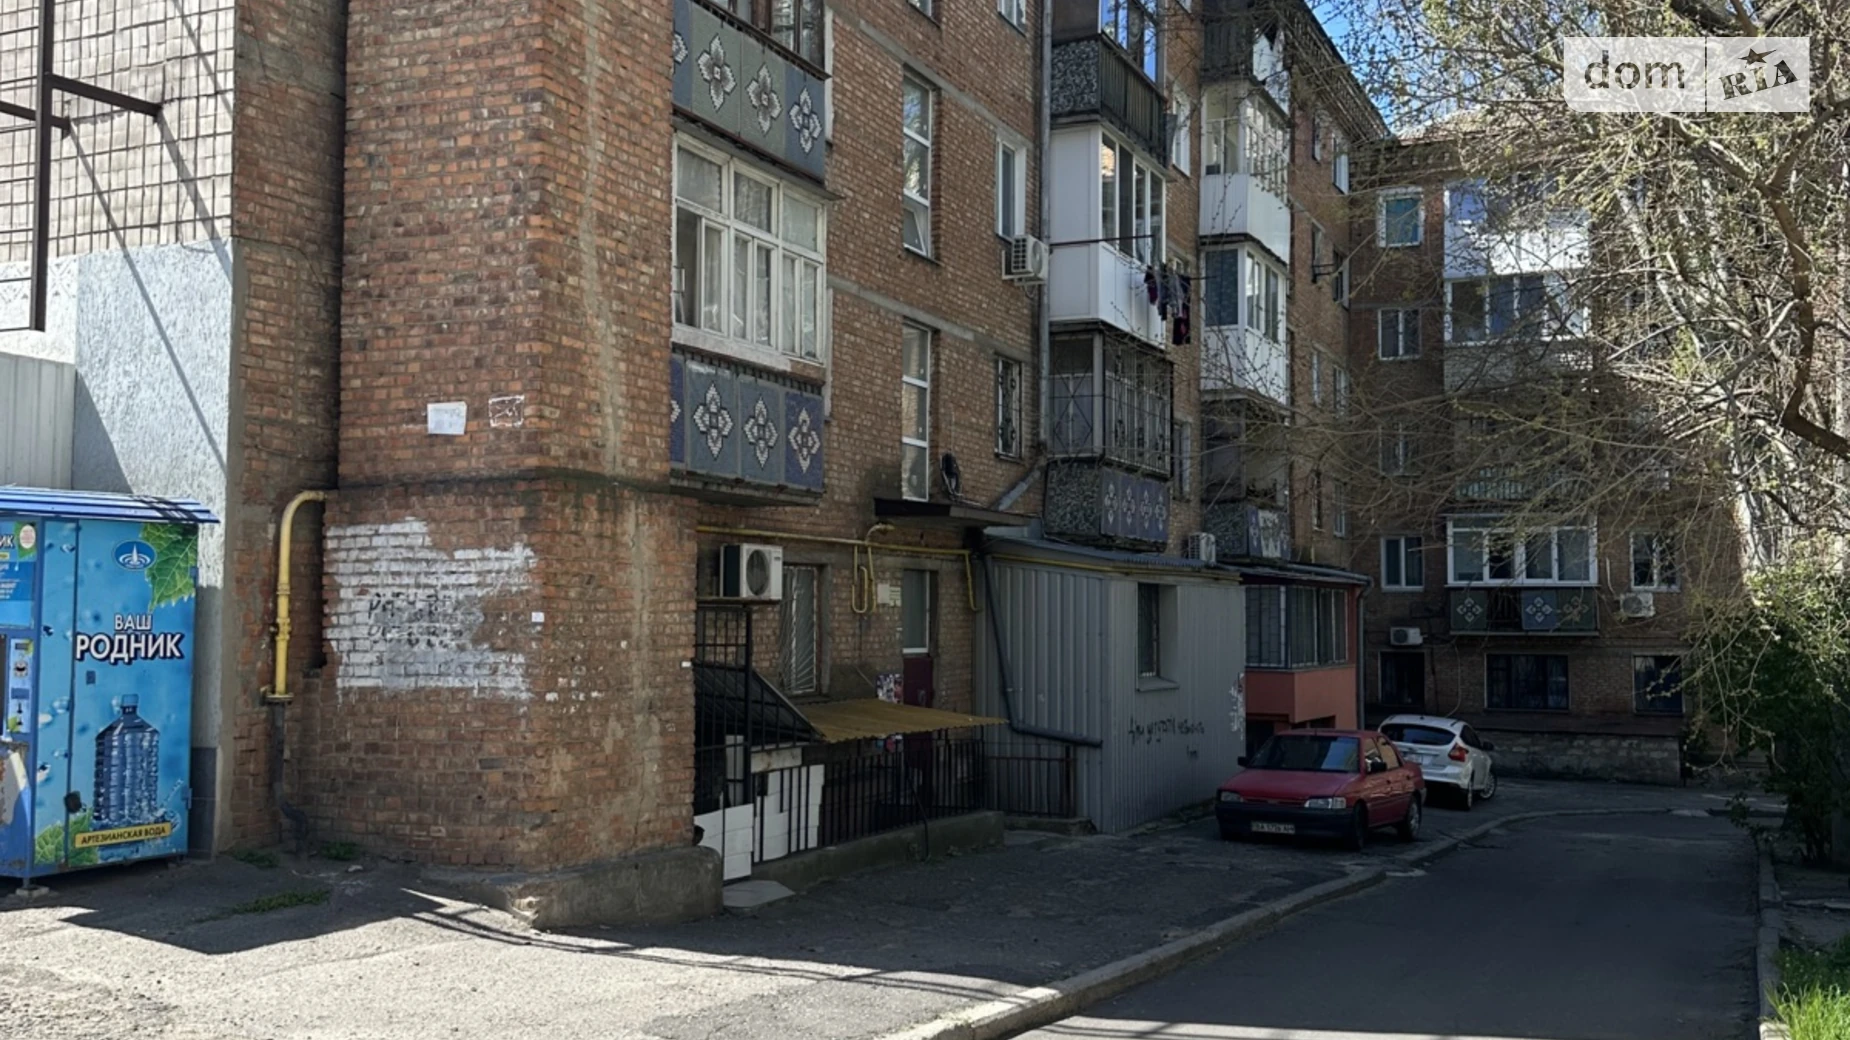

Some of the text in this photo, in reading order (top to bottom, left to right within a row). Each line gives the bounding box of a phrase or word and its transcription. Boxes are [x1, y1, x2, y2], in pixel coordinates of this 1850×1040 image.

[114, 613, 153, 631] ВАШ
[75, 632, 183, 664] РОДНИК
[81, 825, 166, 845] АРТЕЗИАНСКАЯ ВОДА
